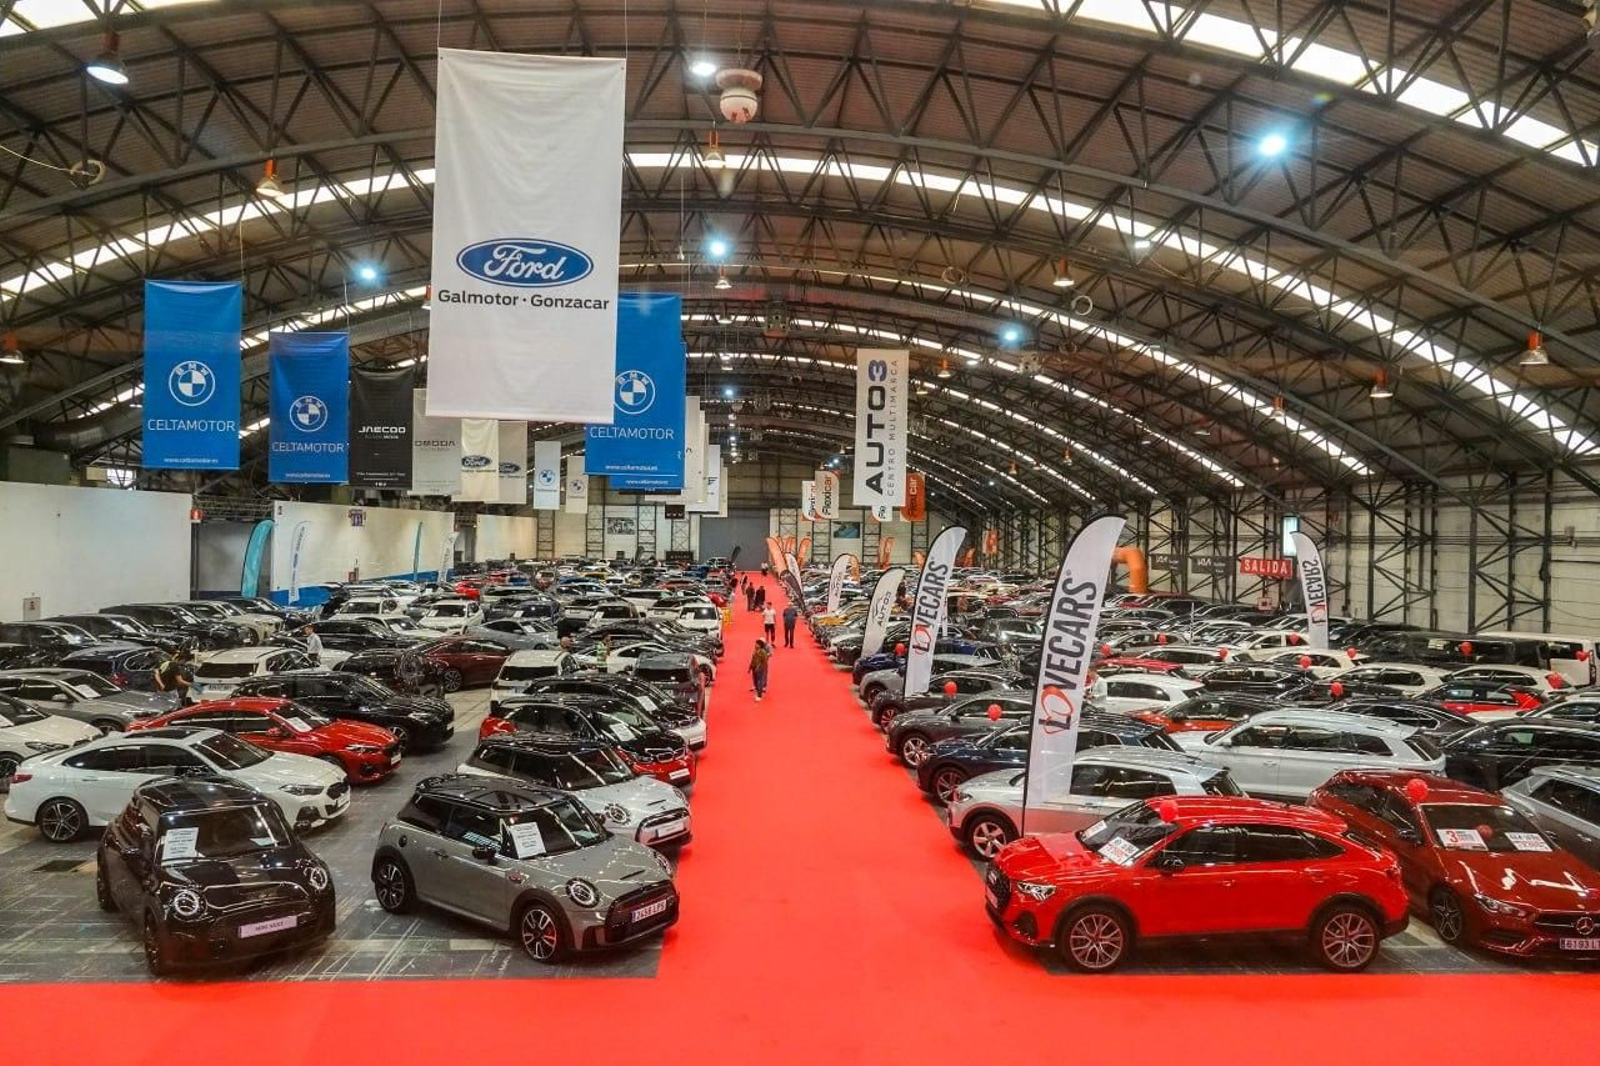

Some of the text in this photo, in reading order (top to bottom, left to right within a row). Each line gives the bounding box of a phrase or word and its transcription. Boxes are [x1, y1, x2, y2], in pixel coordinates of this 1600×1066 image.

[482, 244, 566, 281] Ford
[438, 288, 609, 311] Galmotor Gonzacar
[175, 363, 209, 376] BMW
[147, 418, 236, 432] CELTAMOTOR
[358, 426, 406, 434] JAECOO
[865, 359, 888, 495] AUTO3
[887, 359, 899, 497] CENTRO MULTIMARCA
[589, 426, 675, 440] CELTAMOTOR
[271, 441, 344, 453] CELTAMOTOR
[163, 456, 219, 464] www.celtamotor.es
[822, 475, 832, 516] Flexicar
[1244, 560, 1288, 575] SALIDA
[1446, 830, 1459, 843] 3
